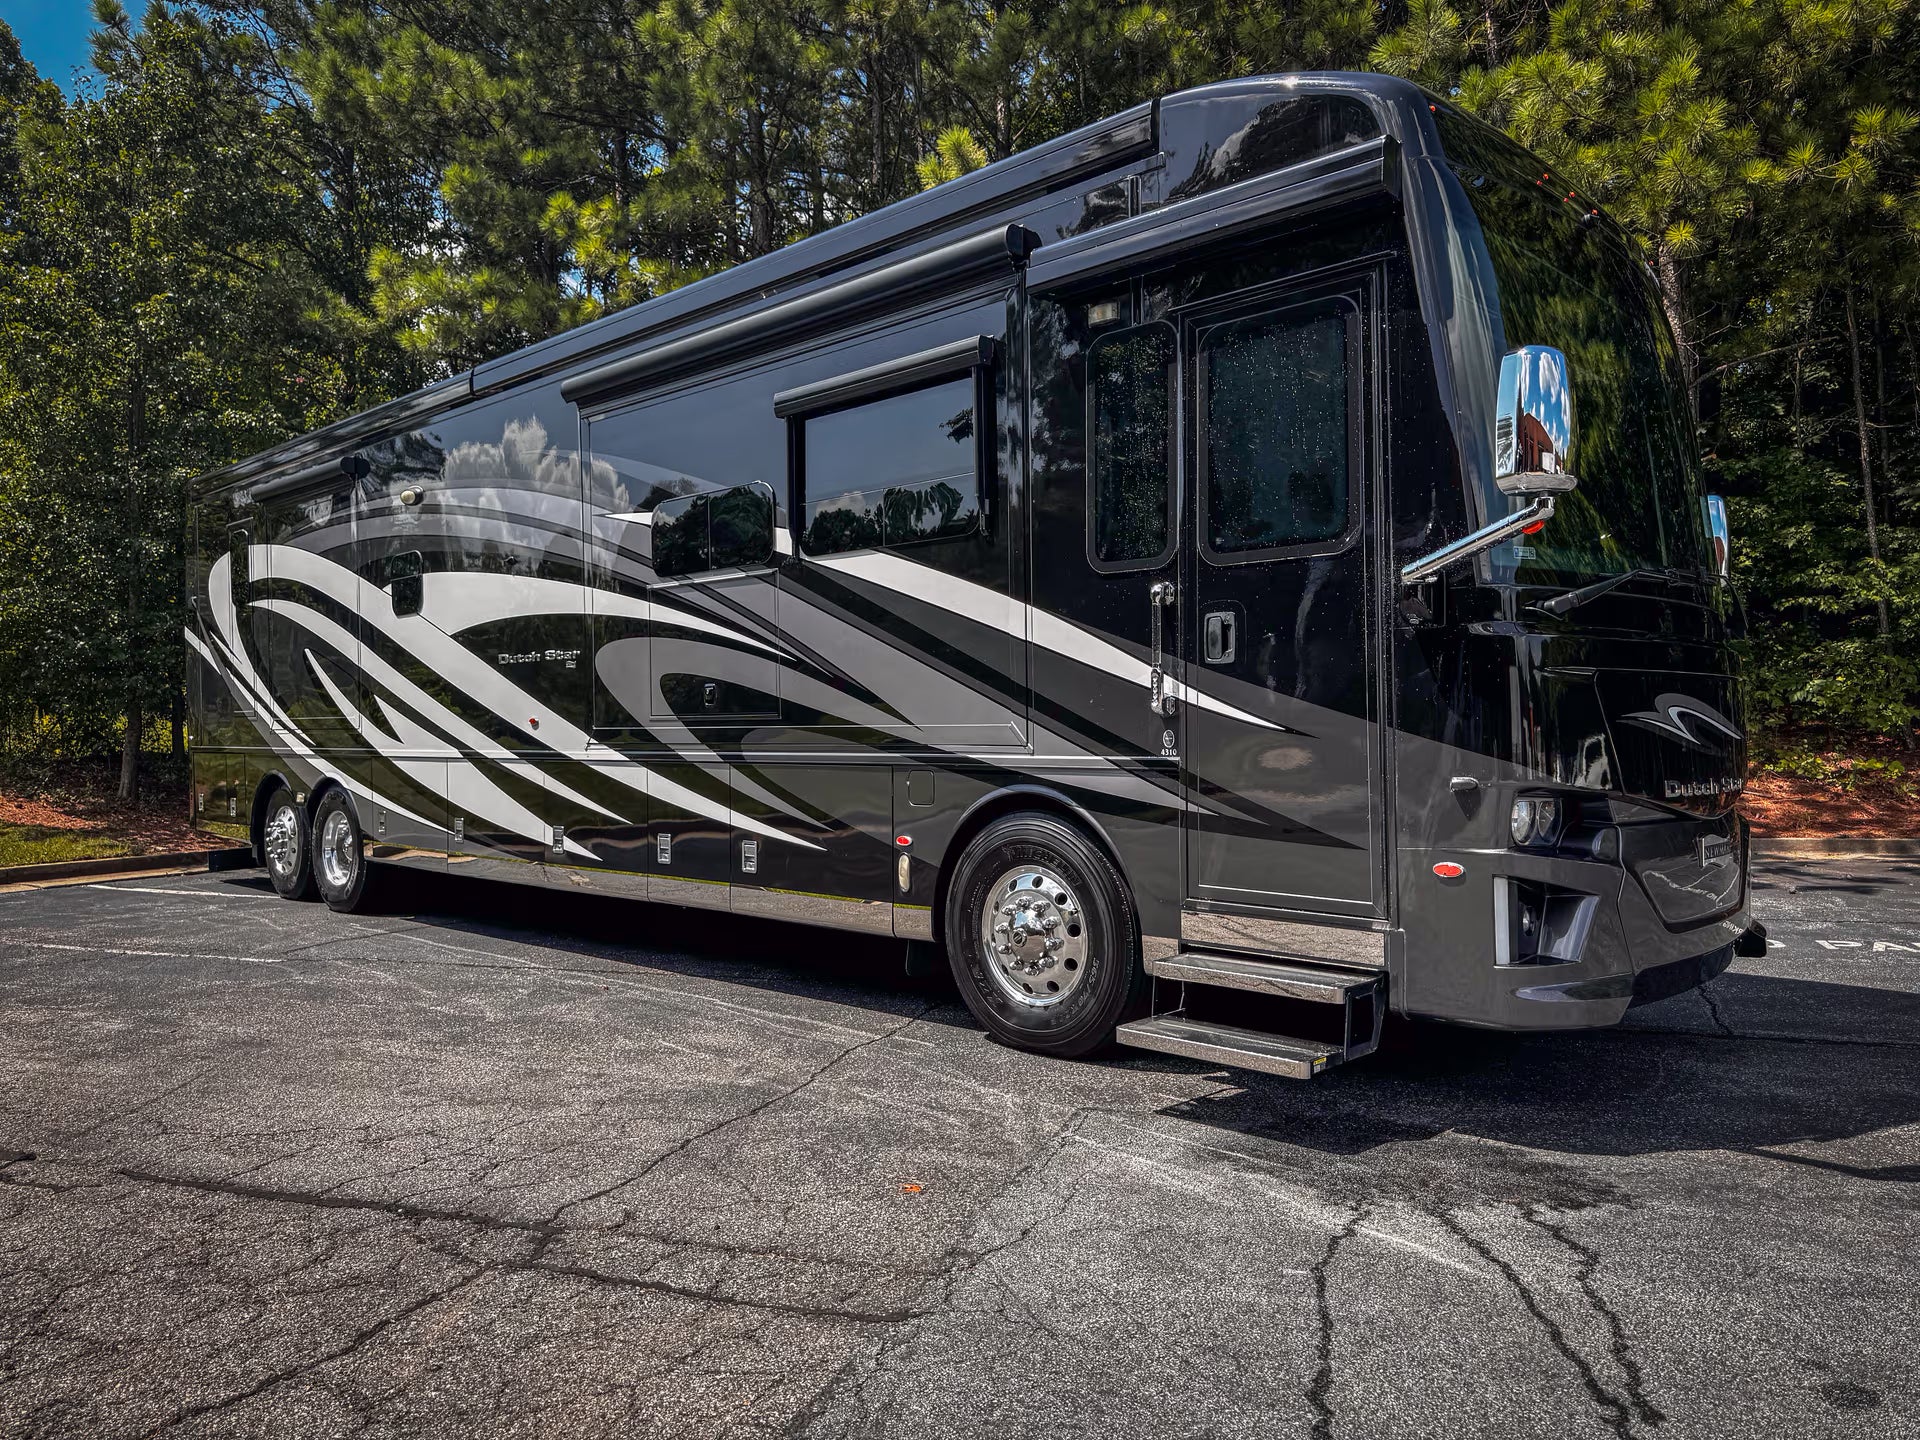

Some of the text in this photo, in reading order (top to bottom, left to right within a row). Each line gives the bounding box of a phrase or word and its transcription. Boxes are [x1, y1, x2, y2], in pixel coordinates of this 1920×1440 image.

[498, 649, 581, 665] Dutch Star
[1160, 748, 1177, 756] 4310
[1664, 777, 1719, 798] Dutch
[1815, 939, 1920, 953] PA
